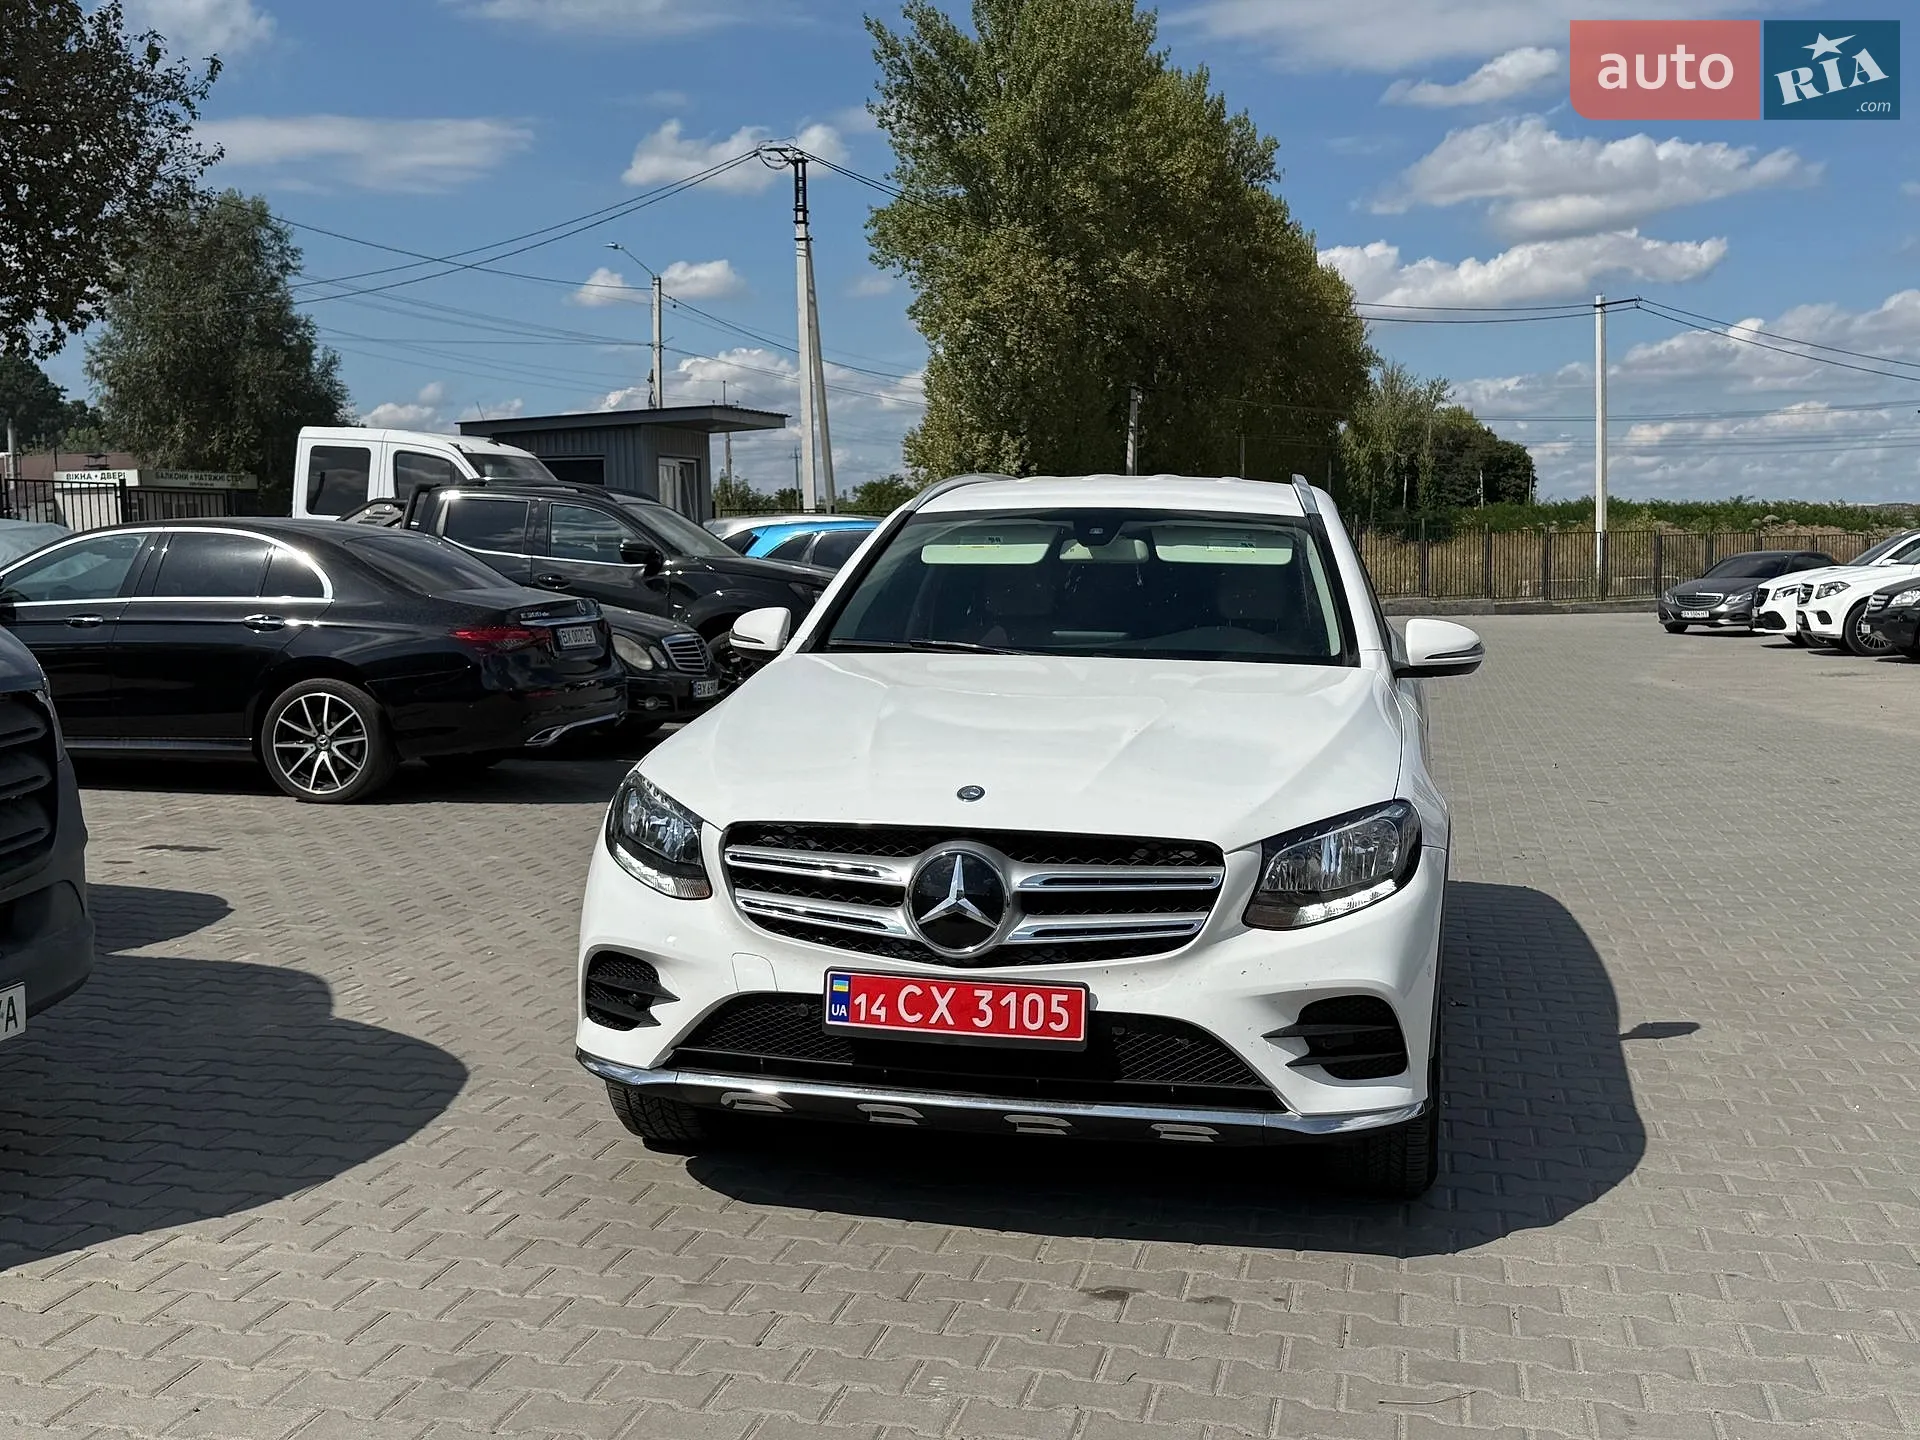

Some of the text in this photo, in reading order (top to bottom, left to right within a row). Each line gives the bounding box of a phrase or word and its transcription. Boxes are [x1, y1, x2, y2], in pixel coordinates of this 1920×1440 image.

[831, 1004, 847, 1016] UA
[854, 984, 1069, 1031] 14 CX 3105
